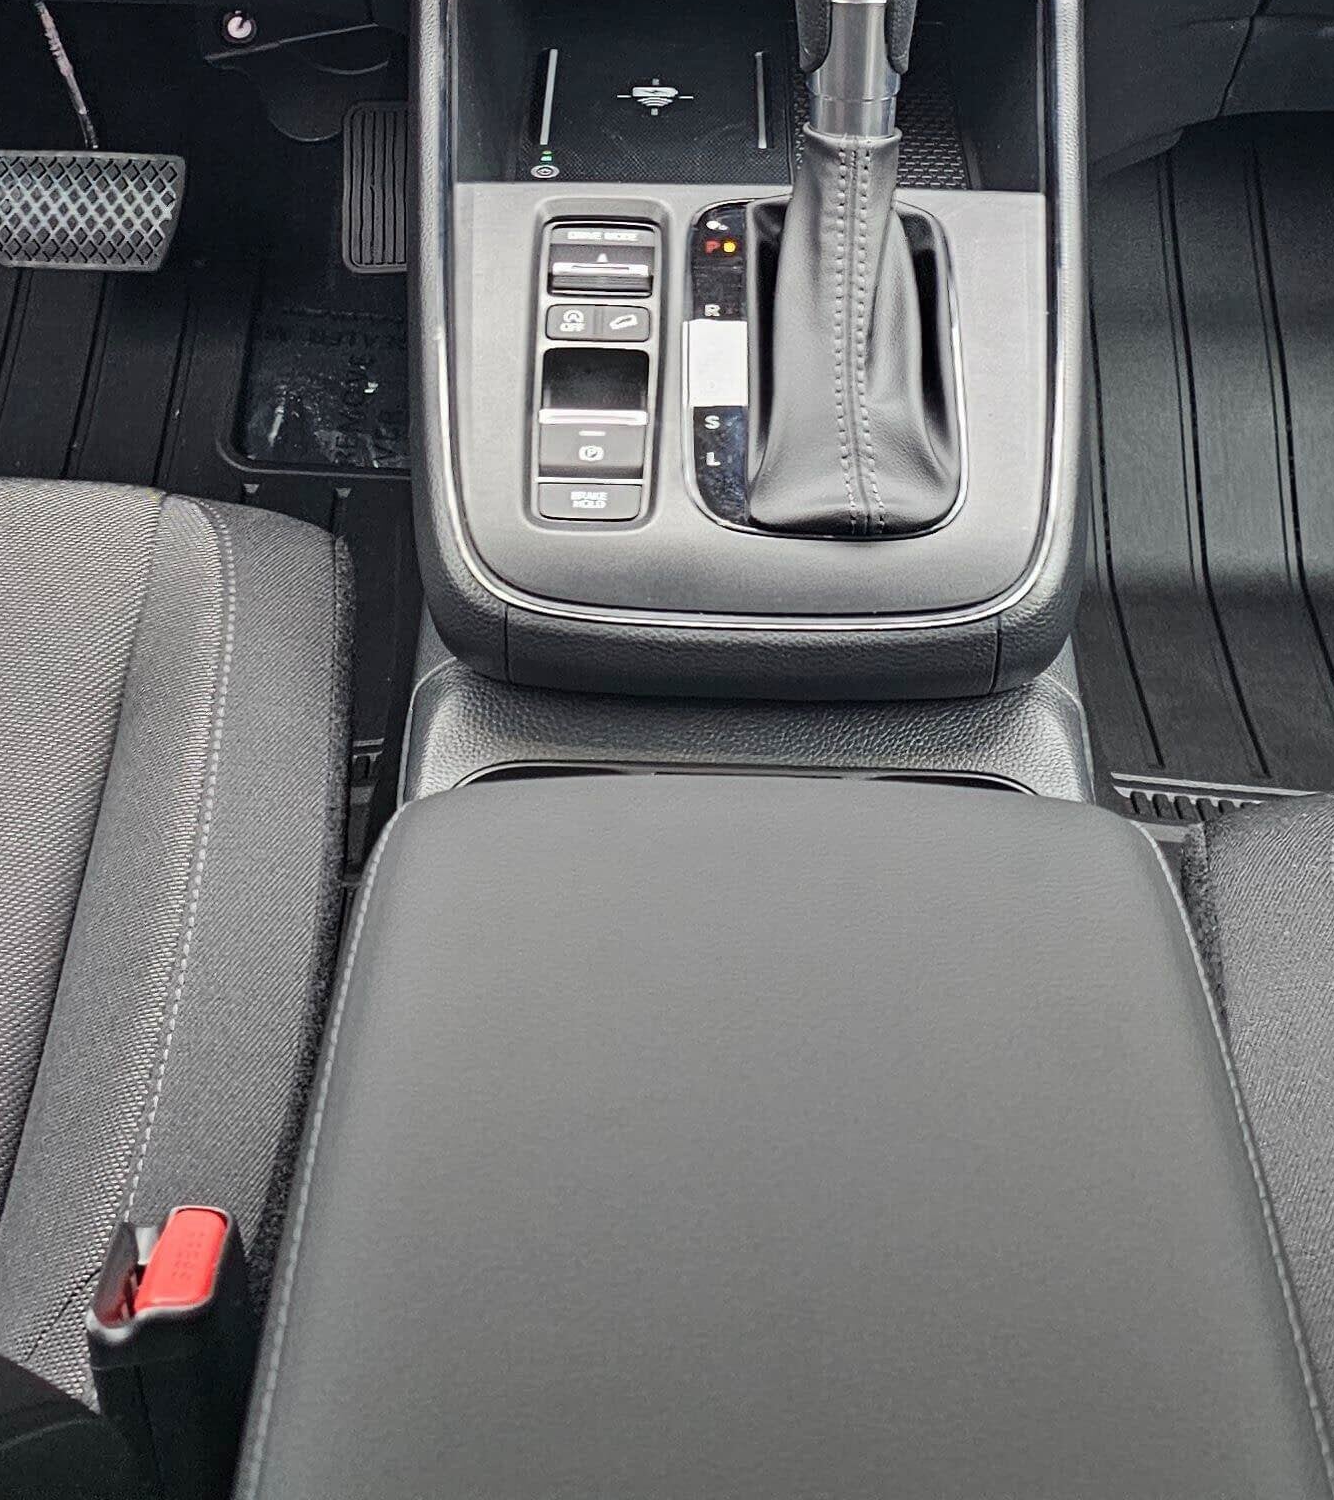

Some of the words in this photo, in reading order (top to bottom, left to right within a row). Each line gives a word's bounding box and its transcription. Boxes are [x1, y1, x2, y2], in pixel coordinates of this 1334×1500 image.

[705, 240, 721, 254] P
[704, 304, 721, 317] R
[704, 415, 721, 430] S
[706, 451, 721, 466] L
